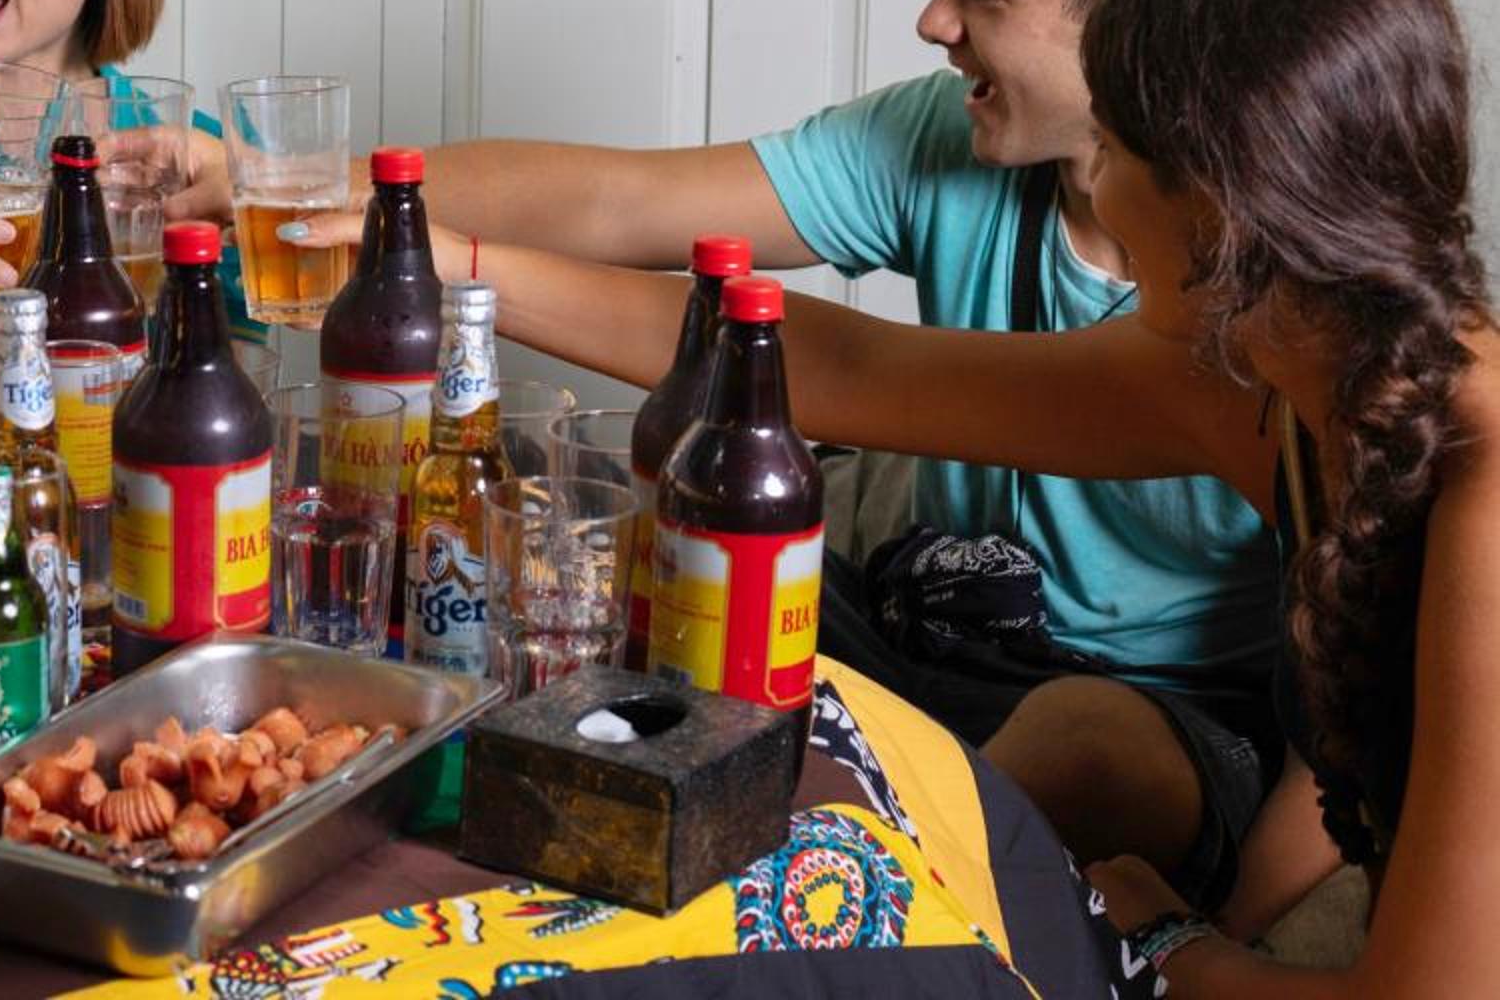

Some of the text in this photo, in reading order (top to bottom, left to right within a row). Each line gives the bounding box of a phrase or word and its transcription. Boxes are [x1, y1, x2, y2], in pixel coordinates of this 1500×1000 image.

[3, 378, 52, 413] Tige
[226, 534, 258, 564] BIA
[780, 604, 811, 635] BIA
